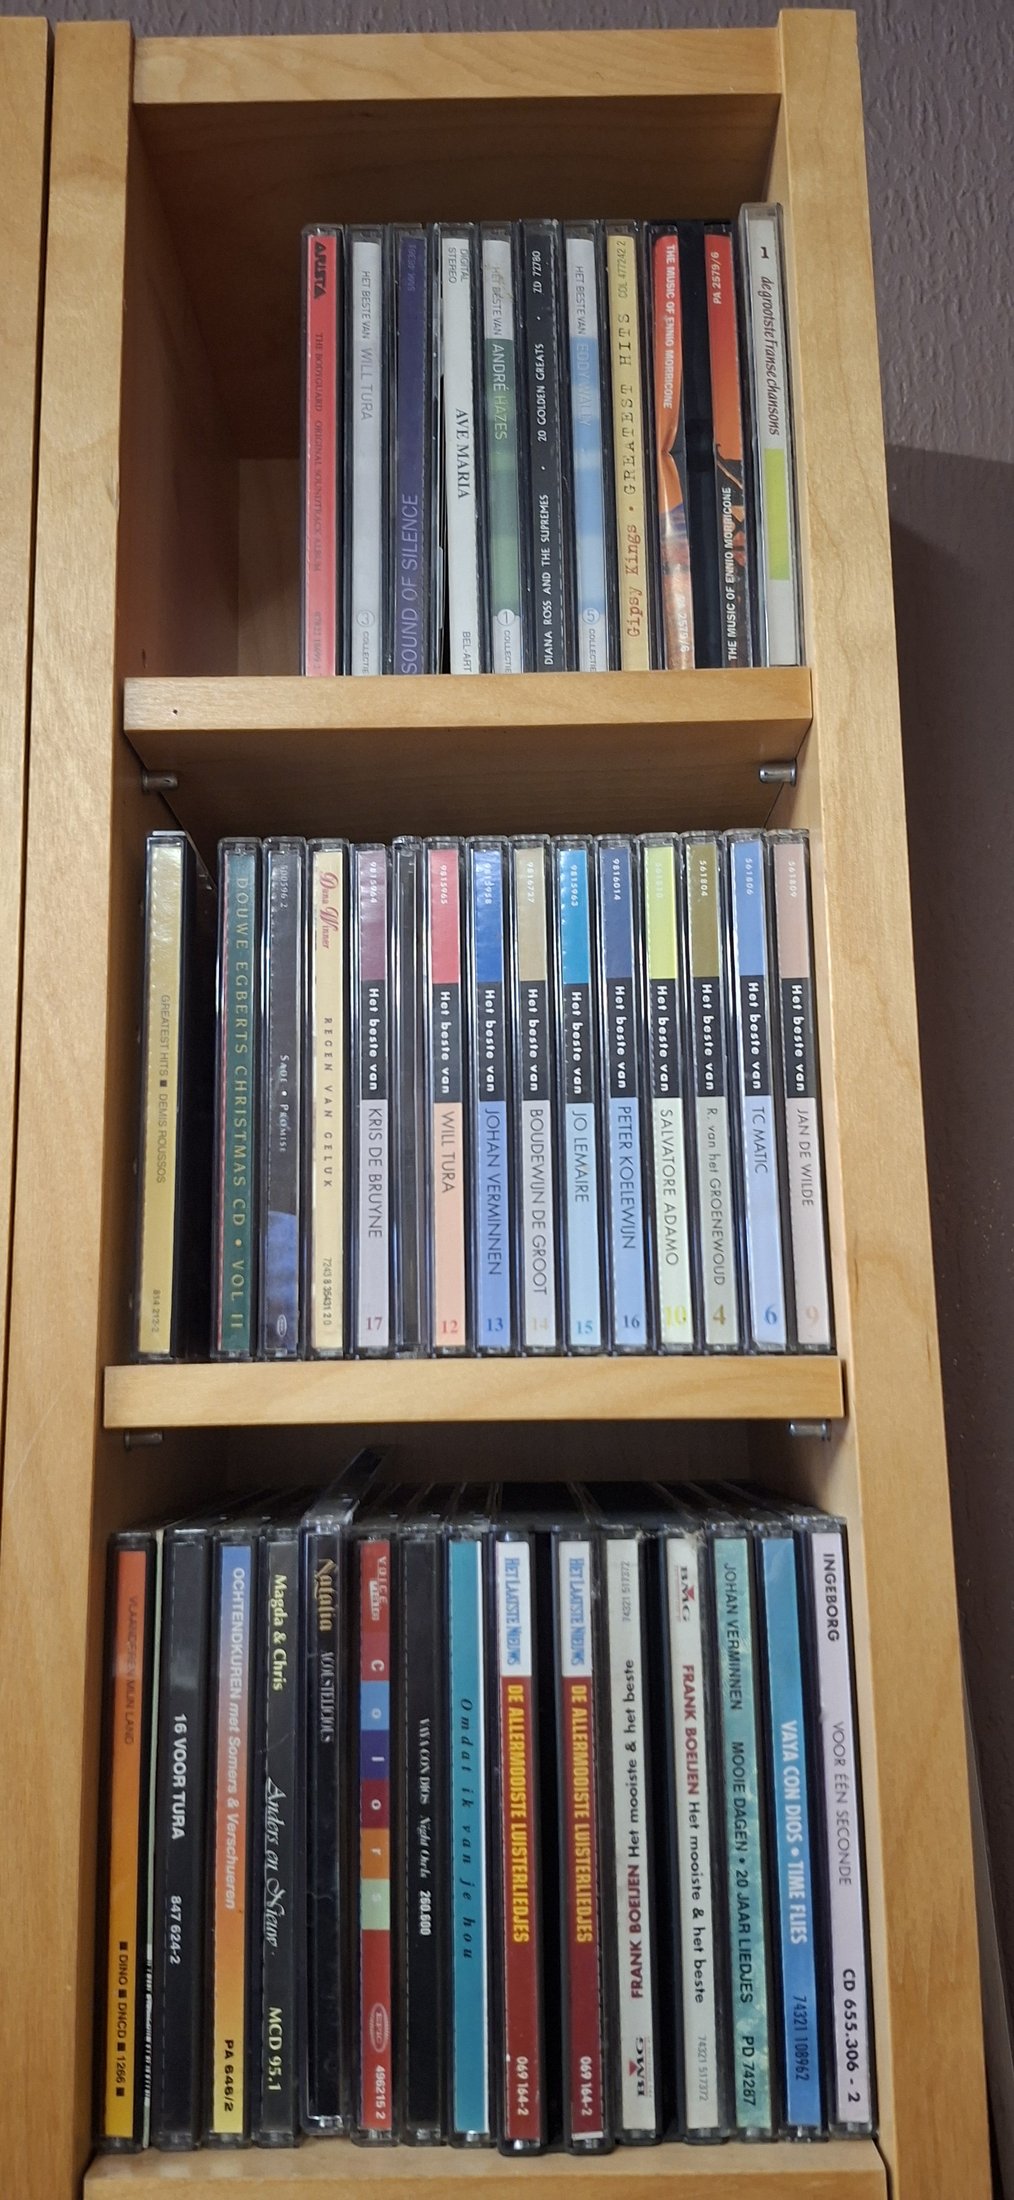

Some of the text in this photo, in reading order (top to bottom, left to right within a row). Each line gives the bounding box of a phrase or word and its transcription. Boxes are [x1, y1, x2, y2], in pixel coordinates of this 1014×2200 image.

[314, 242, 327, 298] ARISTA
[448, 247, 457, 284] STEREO
[460, 248, 469, 282] DIGITAL
[710, 252, 722, 304] PA 2579/6
[760, 276, 774, 290] de
[758, 292, 776, 339] grootste
[360, 347, 373, 421] WILL TURA
[492, 344, 508, 440] ANDRÉ HAZES
[766, 378, 781, 435] chansons
[456, 408, 470, 498] AVE MARIA
[618, 313, 642, 638] Gipsy Kings GREATEST HITS
[535, 344, 554, 665] DIANA ROSS AND THE SUPREMES 20 GOLDEN GREATS
[402, 494, 418, 674] SOUND OF SILENCE
[722, 487, 738, 660] THE MUSIC OF ENNIO MORRICONE
[462, 631, 472, 672] BEL-ART
[157, 995, 170, 1183] GREATEST HITS DEMIS ROUSSOS
[613, 858, 635, 1249] 9816014 PETER KOELEWIJN
[231, 878, 248, 1327] DOUWE EGBERTS CHRISTMAS CD VOL II
[324, 1086, 332, 1117] VAN
[368, 988, 382, 1238] Het beste van KRIS DE BRUYNE
[442, 1111, 455, 1146] WILL
[707, 1107, 718, 1119] R.
[707, 1126, 717, 1148] van
[442, 1152, 455, 1193] TURA
[572, 1111, 589, 1202] JO LEMAIRE
[708, 1154, 719, 1172] het
[752, 1107, 768, 1174] TC MATIC
[797, 1109, 814, 1206] JAN DE WILDE
[486, 1109, 501, 1275] JOHAN VERMINNEN
[530, 1109, 547, 1294] BOUDEWIJN DE GROOT
[660, 1109, 678, 1266] SALVATORE ADAMO
[709, 1178, 725, 1285] GROENEWOUD
[271, 1574, 286, 1626] Magda
[378, 1556, 388, 1604] VOICE
[823, 1554, 839, 1642] INGEBORG
[272, 1648, 287, 1691] Chris
[273, 1631, 286, 1644] &
[224, 1568, 245, 1909] OCHTENDKUREN met Somers & Verschueren
[833, 1722, 846, 1766] VOOR
[170, 1714, 187, 1964] 16 VOOR TURA 847 624-2
[266, 1777, 287, 1845] Anders
[460, 1699, 475, 1958] Omdat ik van je hou
[571, 1685, 592, 1943] DE ALLERMOOISTE LUISTERLIEDJES
[622, 1660, 643, 1998] FRANK BOEIJEN Het mooiste & het beste
[682, 1664, 707, 2003] FRANK BOEIJEN Het mooiste & het beste
[724, 1563, 754, 2057] JOHAN VERMINNEN MOOIE DAGEN 20 JAAR LIEDJES PD
[781, 1721, 807, 1944] VAYA CON DIOS TIME FLIES
[266, 1851, 279, 1870] en
[836, 1810, 852, 1885] SECONDE
[507, 1685, 528, 2116] DE ALLERMOOISTE LUISTERLIEDJES 069 164-2
[117, 1955, 129, 2038] DINO DNCD
[843, 1969, 855, 1990] CD
[268, 2007, 281, 2049] MCD
[844, 2000, 859, 2071] 655.306
[224, 2040, 234, 2112] PA 646/2
[268, 2056, 281, 2091] 95.1
